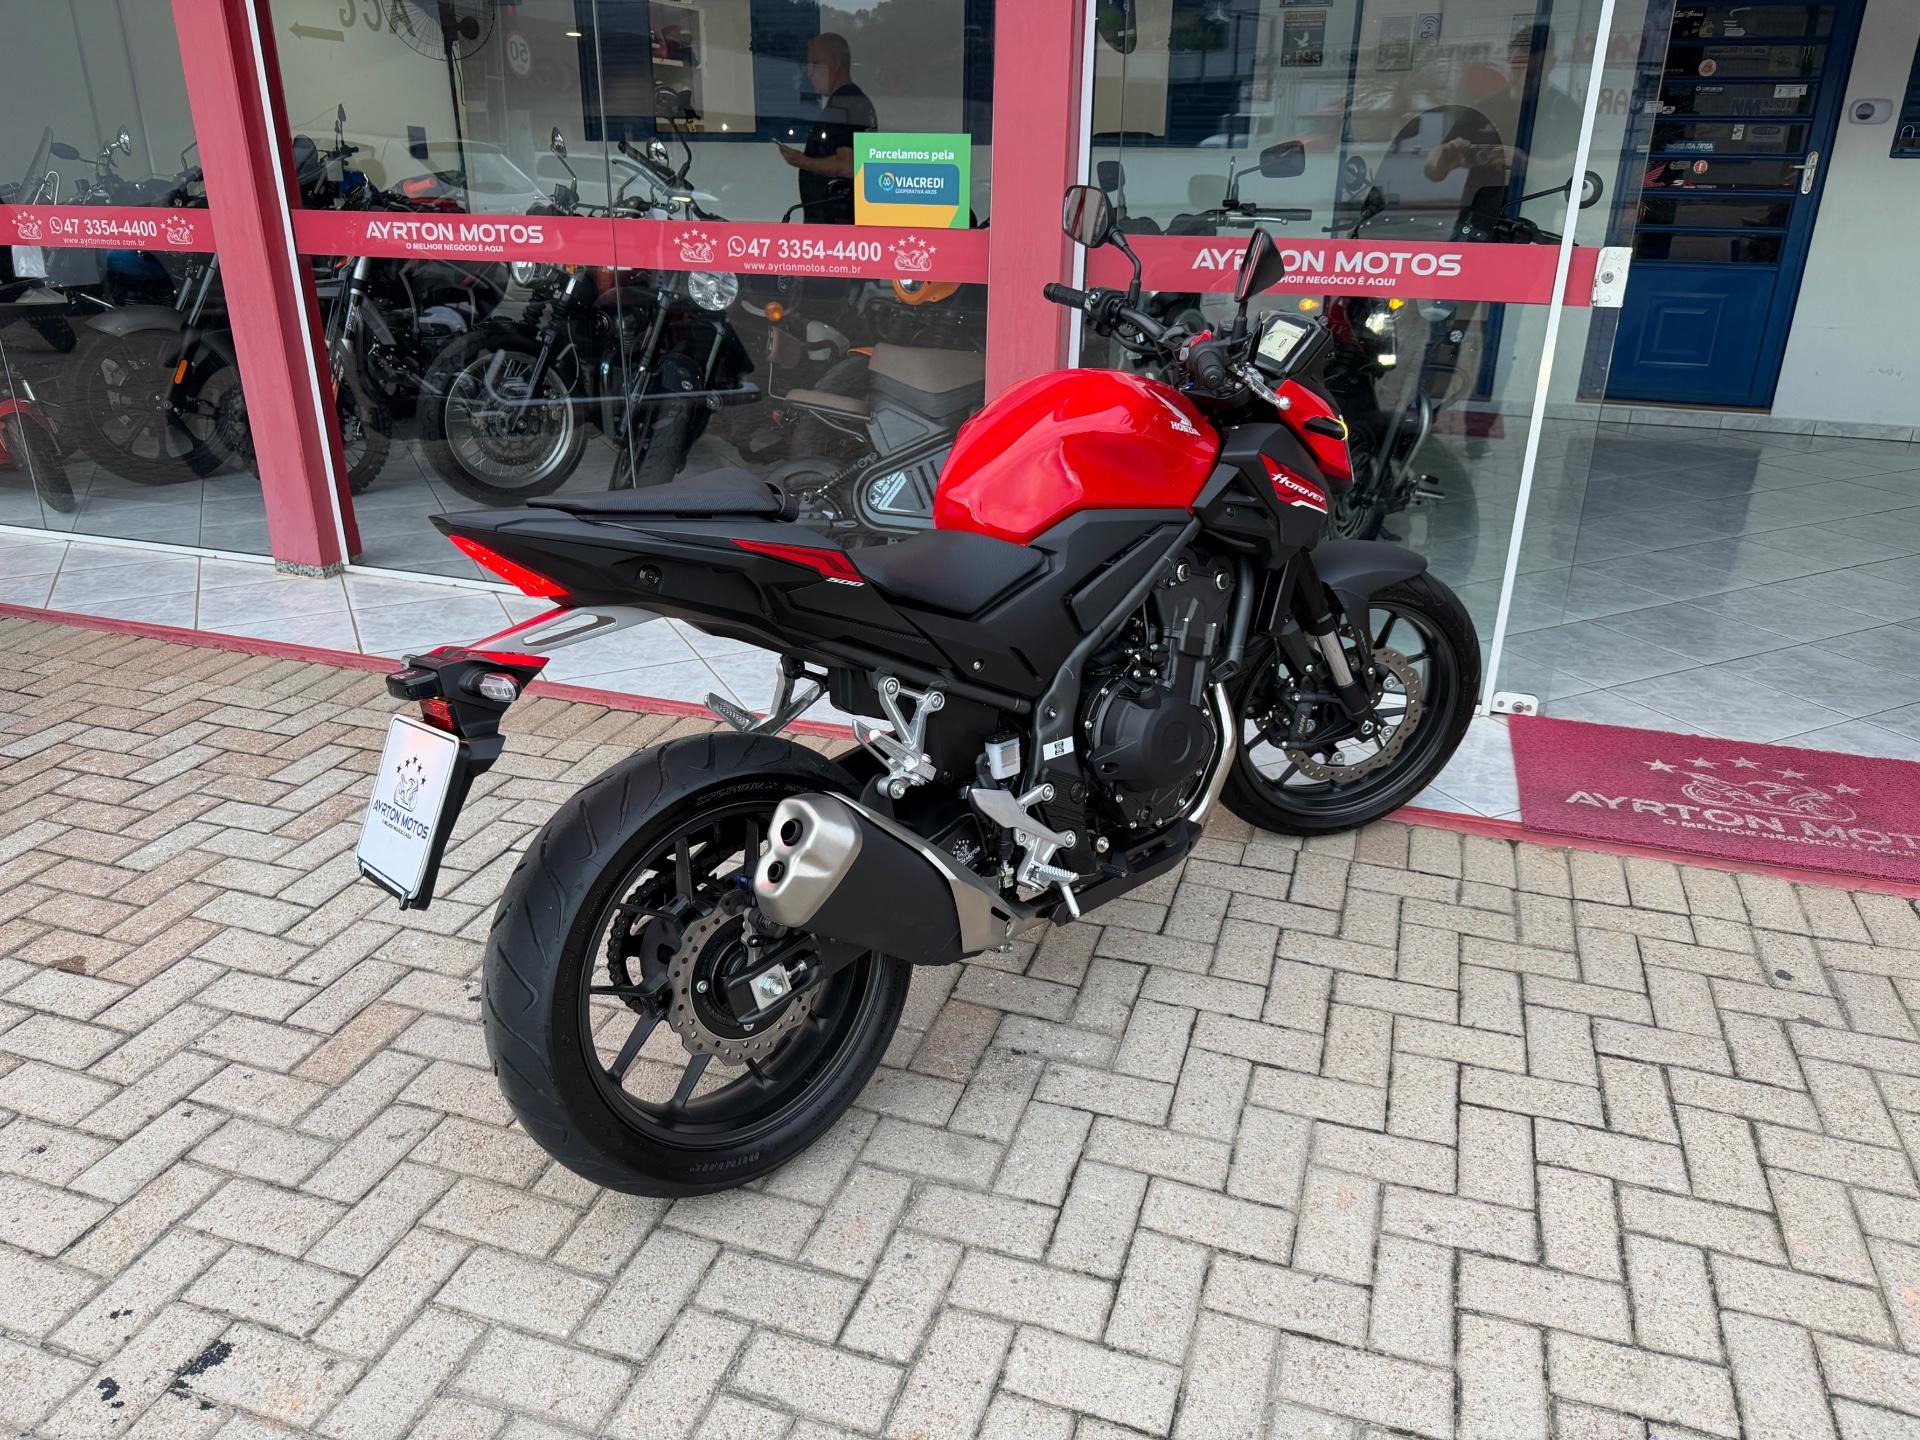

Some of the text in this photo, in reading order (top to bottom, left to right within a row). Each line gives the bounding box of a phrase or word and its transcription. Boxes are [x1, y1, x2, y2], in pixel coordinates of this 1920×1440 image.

[868, 148, 955, 162] Parcelamos pela
[895, 176, 944, 189] VIACREDI
[64, 218, 158, 238] 47 3354-4400
[366, 220, 544, 244] AYRTON MOTOS
[63, 237, 146, 247] www.ayrtonmotos.com.br
[405, 242, 412, 250] O
[412, 242, 443, 251] MELHOR
[443, 242, 478, 252] NEGÓCIO
[484, 244, 504, 253] AQUI
[747, 238, 882, 262] 47 3354-4400
[743, 261, 862, 275] www.ayrtonmotos.com.br
[1334, 250, 1463, 277] MOTOS
[1305, 274, 1356, 286] NEGÓCIO
[1366, 276, 1397, 287] AQUI
[1170, 420, 1201, 436] HONDA
[825, 577, 865, 588] 500
[1566, 790, 1787, 832] AYRTON
[373, 799, 401, 825] AYRTON
[401, 814, 429, 840] MOTOS
[1680, 821, 1758, 837] MELHOR
